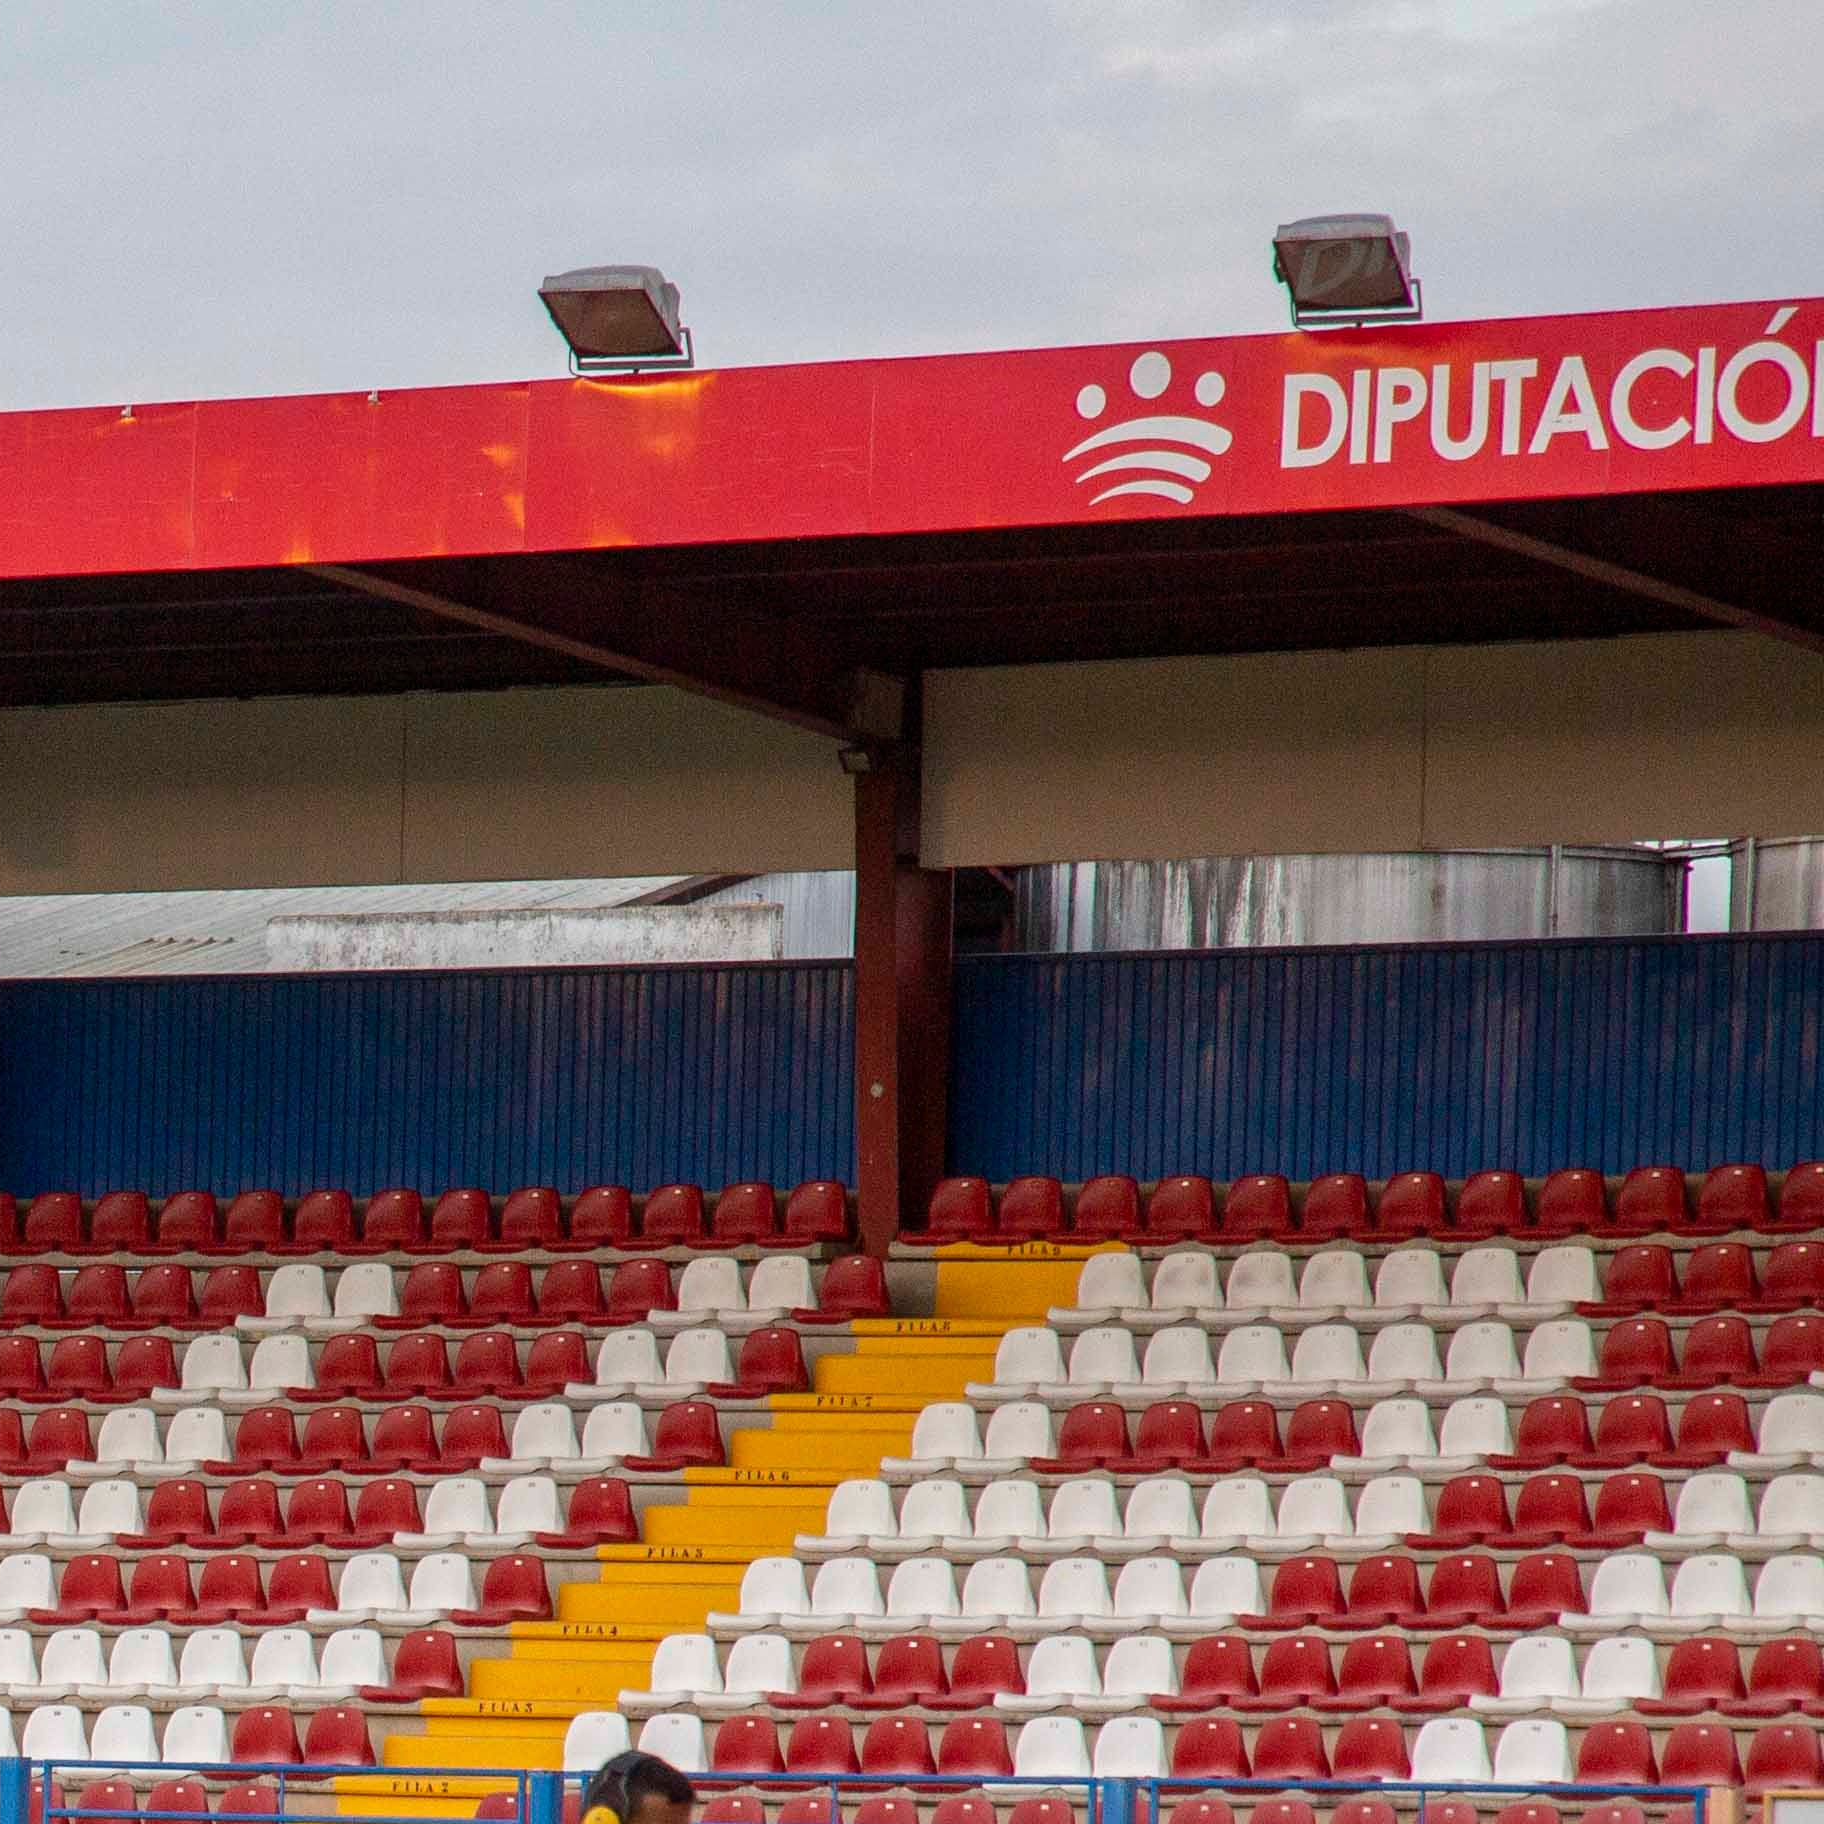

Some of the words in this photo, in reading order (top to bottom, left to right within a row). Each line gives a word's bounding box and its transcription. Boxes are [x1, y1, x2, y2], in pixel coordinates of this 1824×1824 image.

[1279, 307, 1824, 469] DIPUTACIÓ
[735, 1470, 776, 1482] FILA
[647, 1547, 690, 1559] FILA
[563, 1625, 604, 1636] FILA
[479, 1702, 520, 1714] FILA
[392, 1781, 433, 1793] FILA
